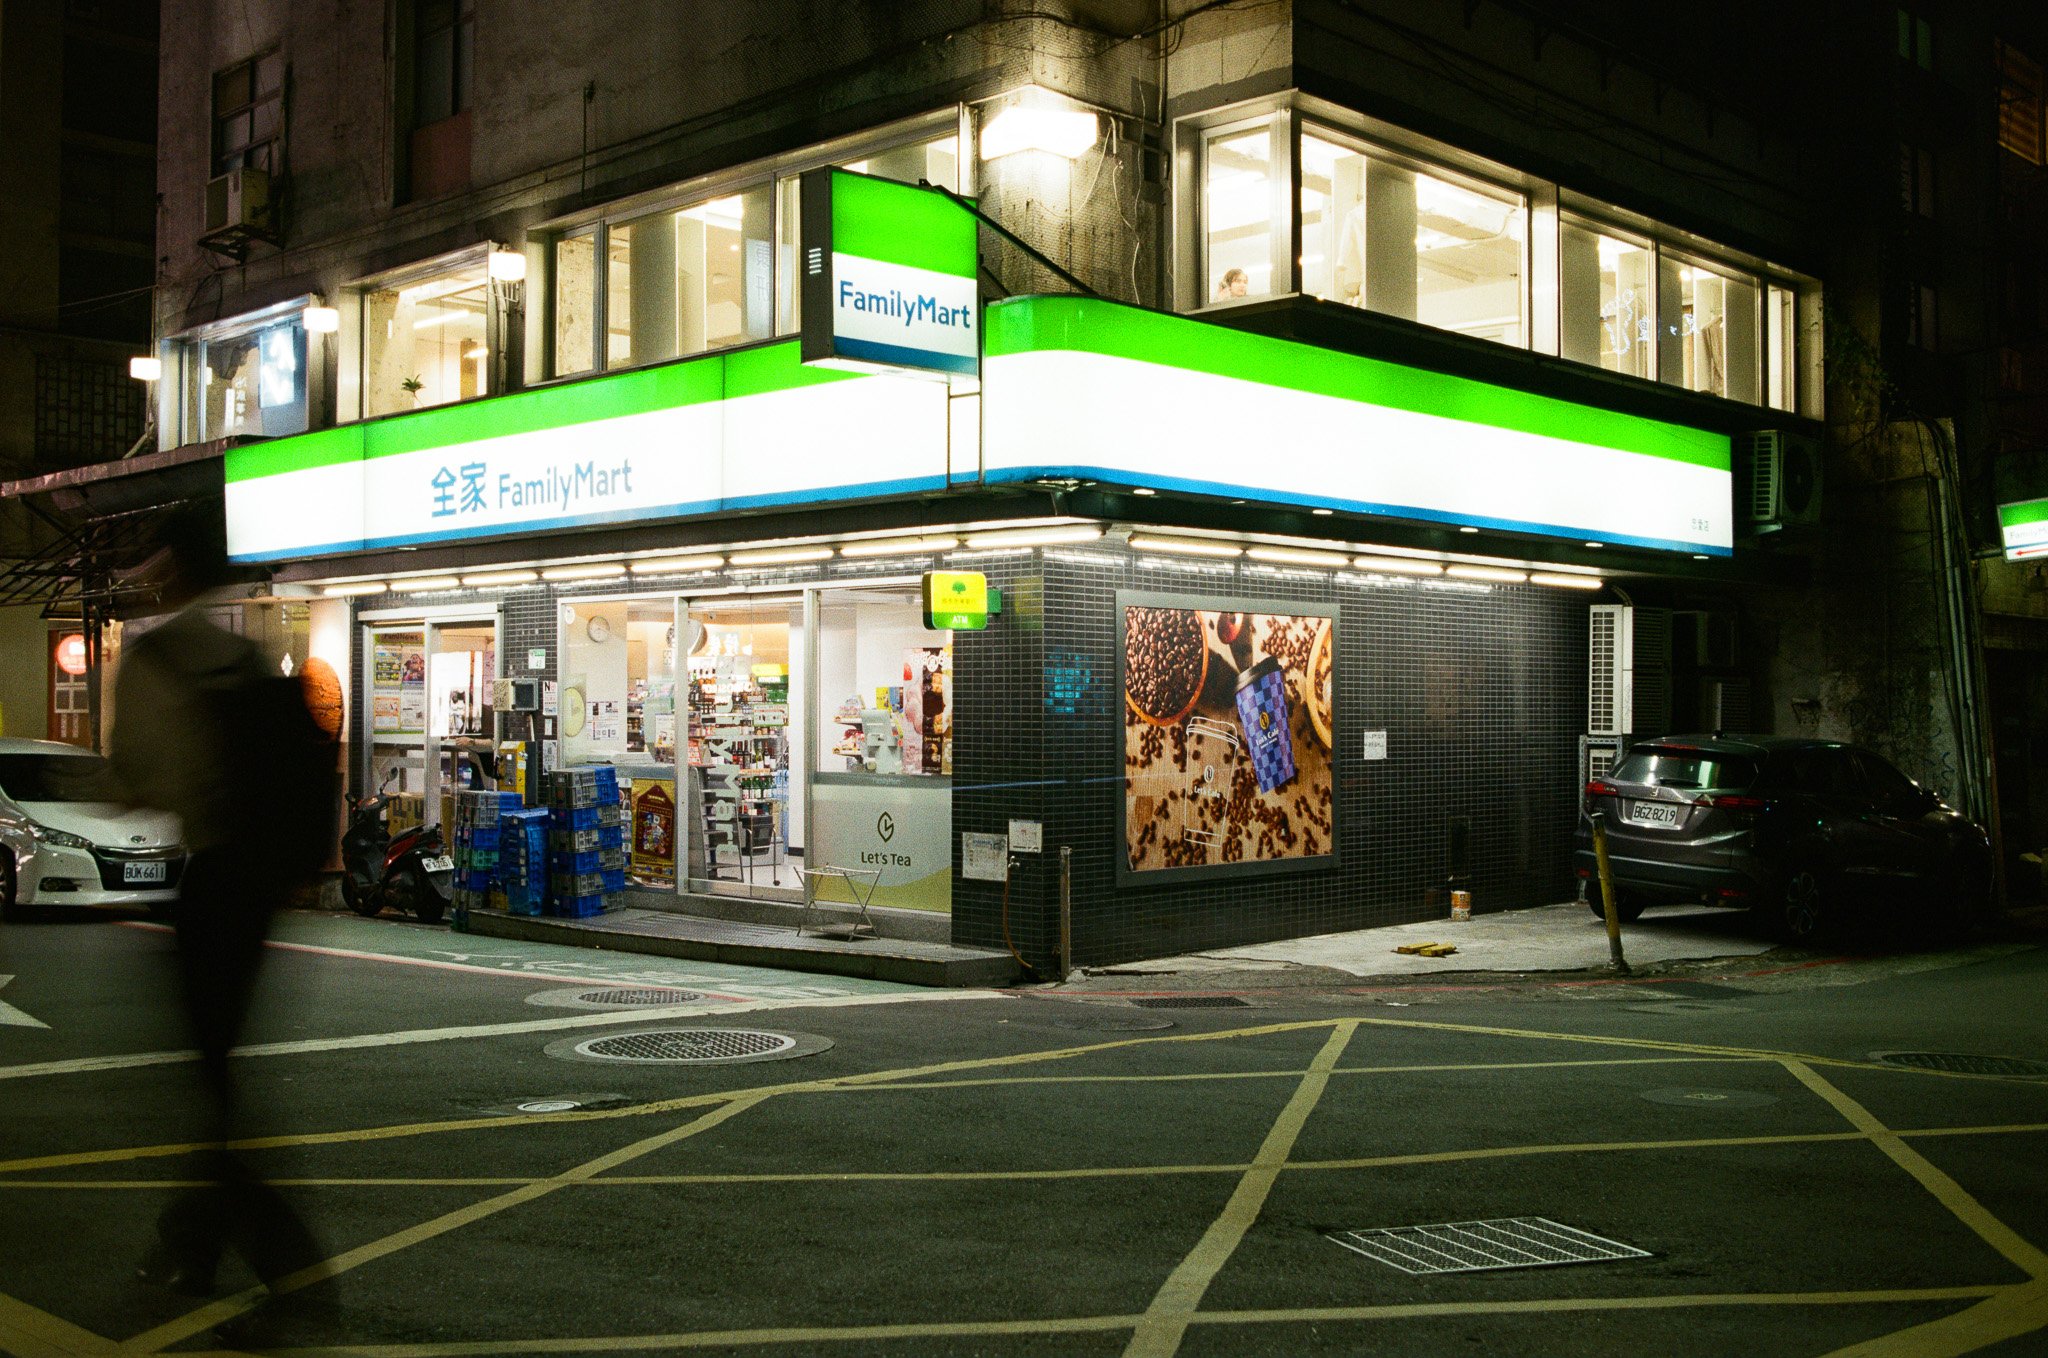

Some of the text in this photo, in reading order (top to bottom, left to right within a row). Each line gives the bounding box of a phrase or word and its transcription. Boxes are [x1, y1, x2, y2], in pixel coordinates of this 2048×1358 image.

[840, 280, 970, 329] FamilyMart
[431, 458, 632, 517] 全家 FamilyMart
[952, 615, 968, 624] ATM
[1634, 806, 1676, 822] BGZ-8219
[861, 851, 911, 867] Let's Tea
